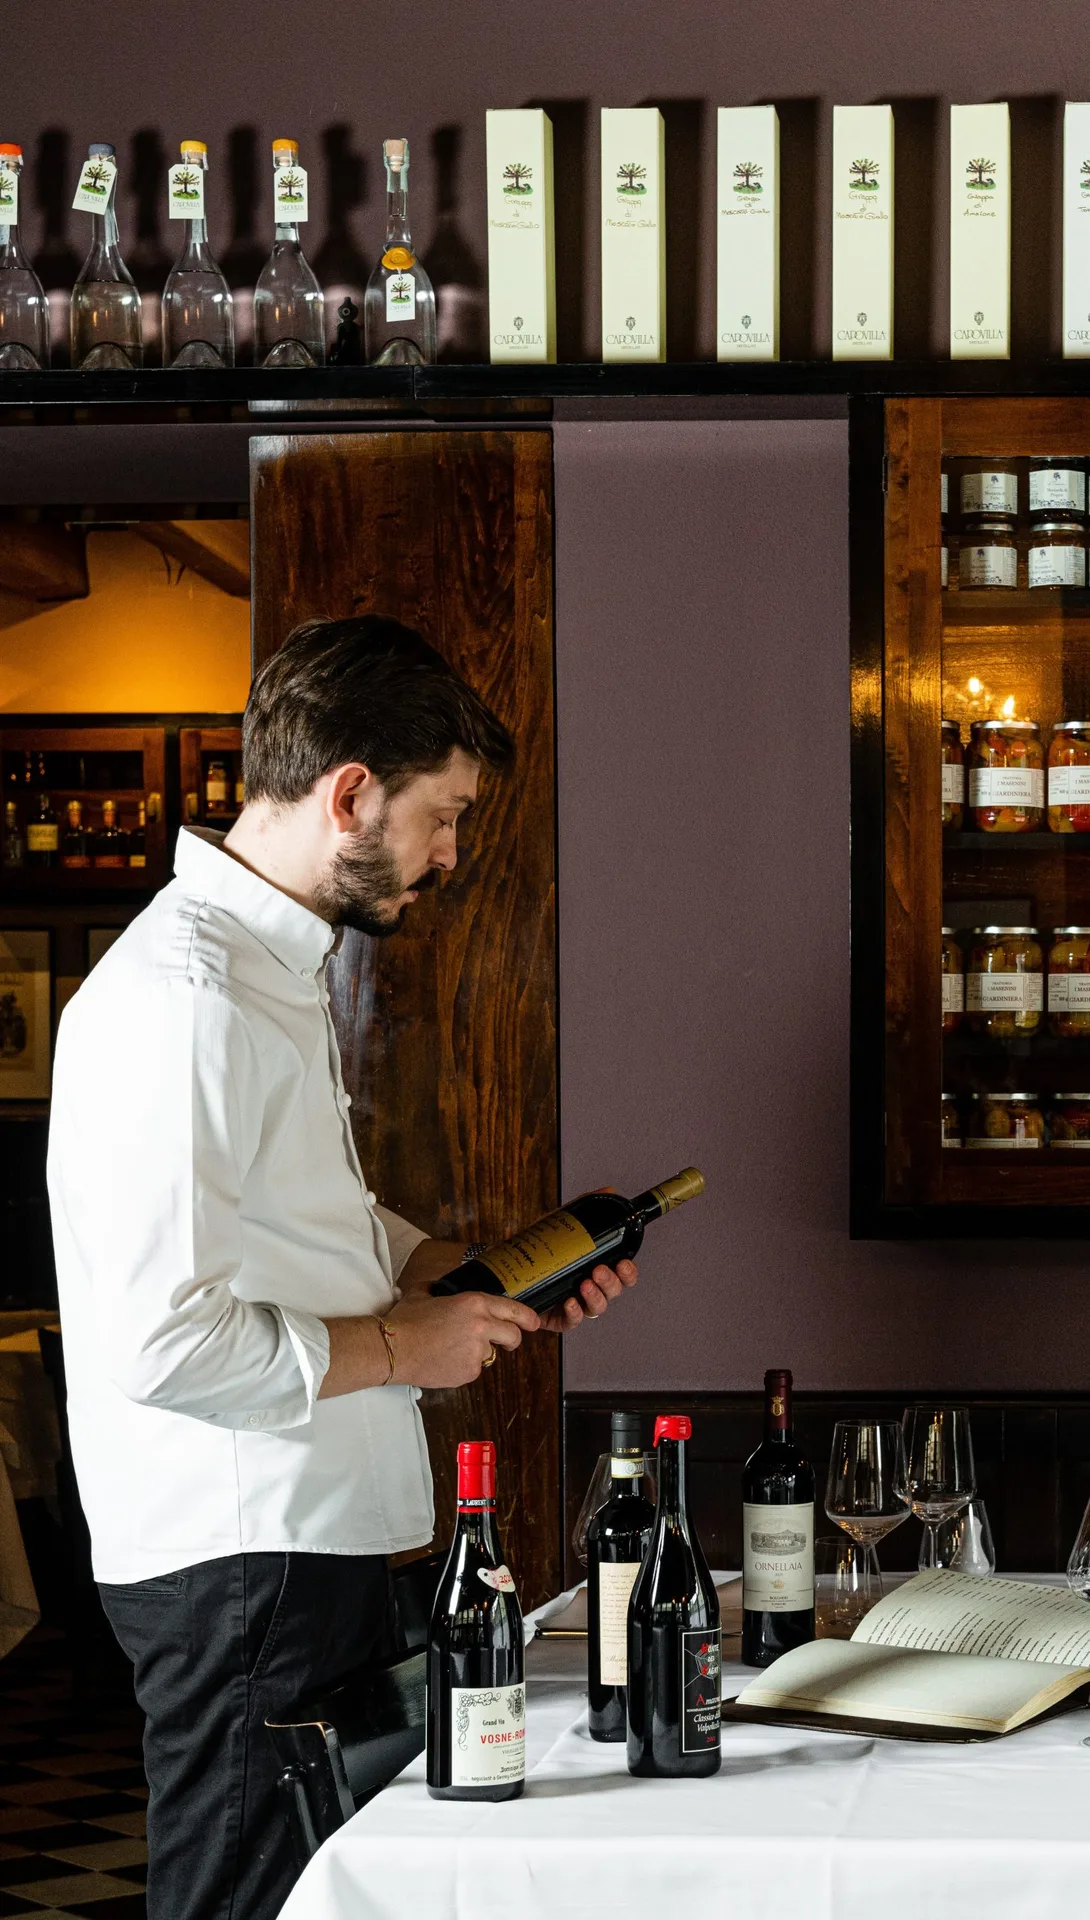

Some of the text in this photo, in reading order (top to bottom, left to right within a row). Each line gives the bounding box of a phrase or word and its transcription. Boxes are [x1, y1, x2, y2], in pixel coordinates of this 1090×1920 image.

[494, 334, 543, 345] CAPOVILLA
[605, 334, 655, 345] CAPOVILLA
[721, 332, 771, 343] CAPOVILLA
[836, 330, 887, 341] CAPOVILLA
[953, 329, 1005, 340] CAPOVILLA
[466, 1498, 487, 1506] LAURENT
[754, 1561, 803, 1572] ORNELLAIA
[482, 1718, 498, 1726] Grand
